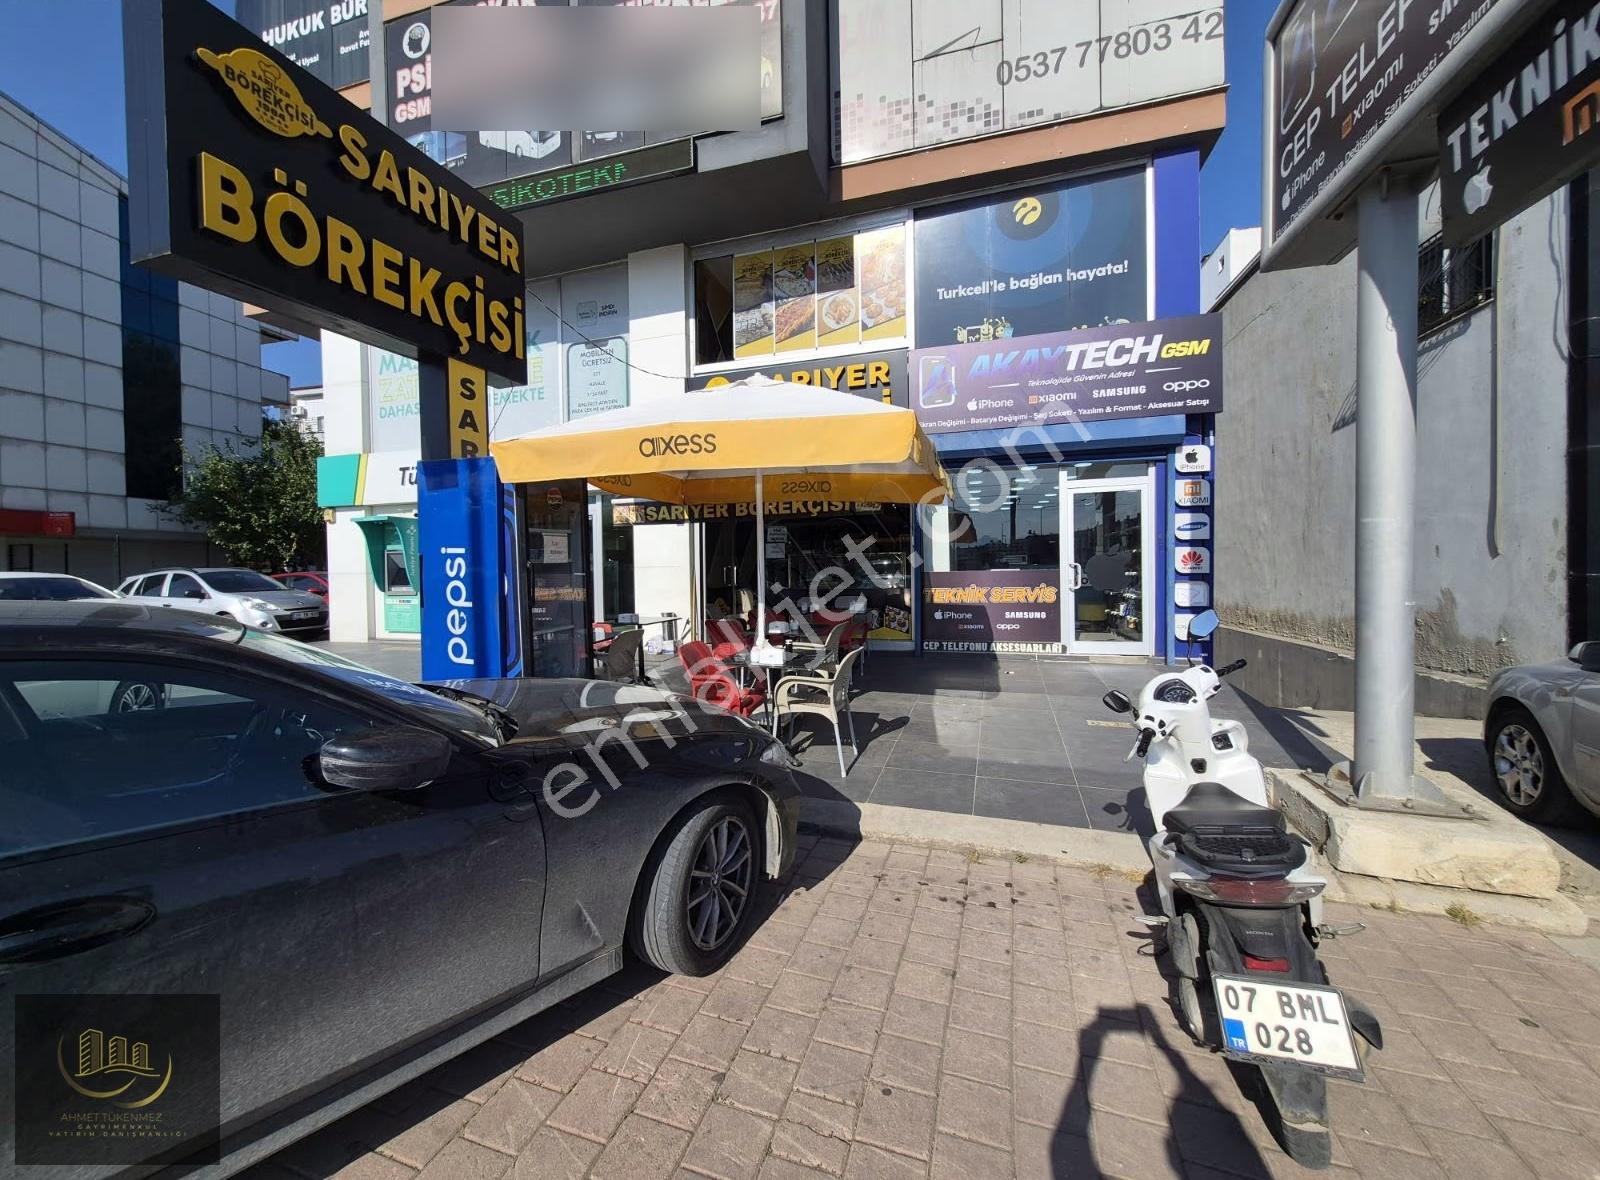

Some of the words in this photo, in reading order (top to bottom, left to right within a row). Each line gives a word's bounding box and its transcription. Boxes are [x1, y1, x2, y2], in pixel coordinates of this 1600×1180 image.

[996, 47, 1068, 87] 0537
[1075, 23, 1172, 69] 77803
[1181, 11, 1224, 43] 42
[224, 65, 314, 130] BÖREKÇİSİ
[1281, 106, 1321, 178] CEP
[1290, 150, 1326, 200] iPhone
[337, 124, 521, 275] SARIYER
[200, 151, 524, 360] BÖREKÇİSİ
[936, 280, 1006, 300] Turkcell'le
[1009, 272, 1063, 291] bağlan
[1066, 259, 1129, 283] hayata!
[1161, 339, 1211, 359] GSM
[1109, 369, 1135, 379] Adresi
[979, 399, 1014, 409] iPhone
[1092, 385, 1147, 398] SAMSUNG
[1163, 379, 1210, 392] oppo
[1113, 403, 1142, 412] Format
[1147, 400, 1184, 410] Aksesuar
[1186, 398, 1210, 408] Satışı
[645, 501, 729, 521] SARIYER
[1178, 496, 1209, 504] XIAOMI
[440, 547, 475, 665] pepsi
[924, 584, 989, 603] TEKNİK
[988, 583, 1058, 604] SERVİS
[943, 611, 973, 620] iPhone
[1005, 611, 1047, 619] SAMSUNG
[923, 642, 939, 650] CEP
[942, 642, 988, 652] TELEFONU
[1224, 985, 1257, 1013] 07
[1276, 990, 1340, 1026] BML
[1231, 1037, 1247, 1048] TR
[1255, 1021, 1314, 1056] 028
